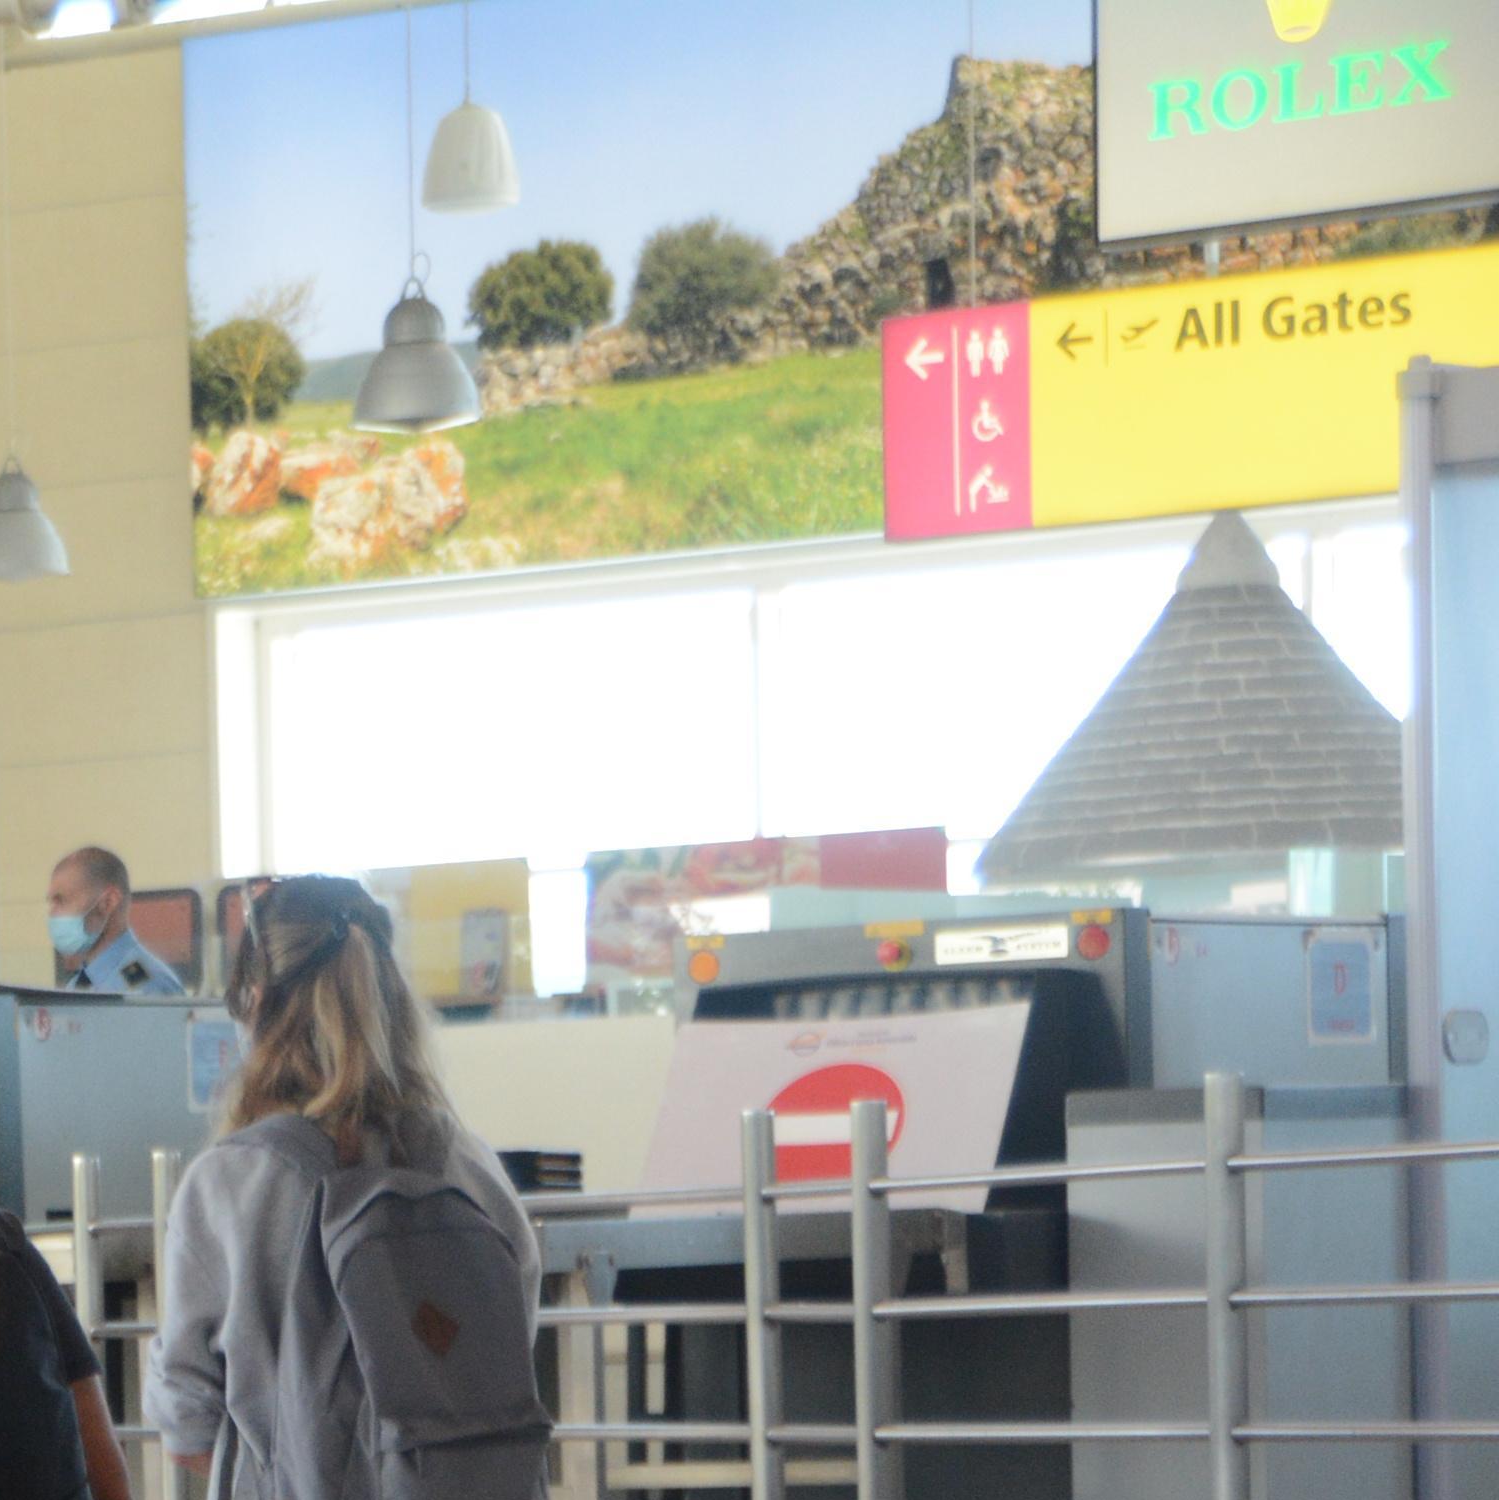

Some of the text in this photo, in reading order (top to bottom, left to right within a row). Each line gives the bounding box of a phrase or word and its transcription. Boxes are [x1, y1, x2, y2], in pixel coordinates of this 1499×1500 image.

[1146, 40, 1452, 141] ROLEX
[1174, 291, 1413, 352] All Gates
